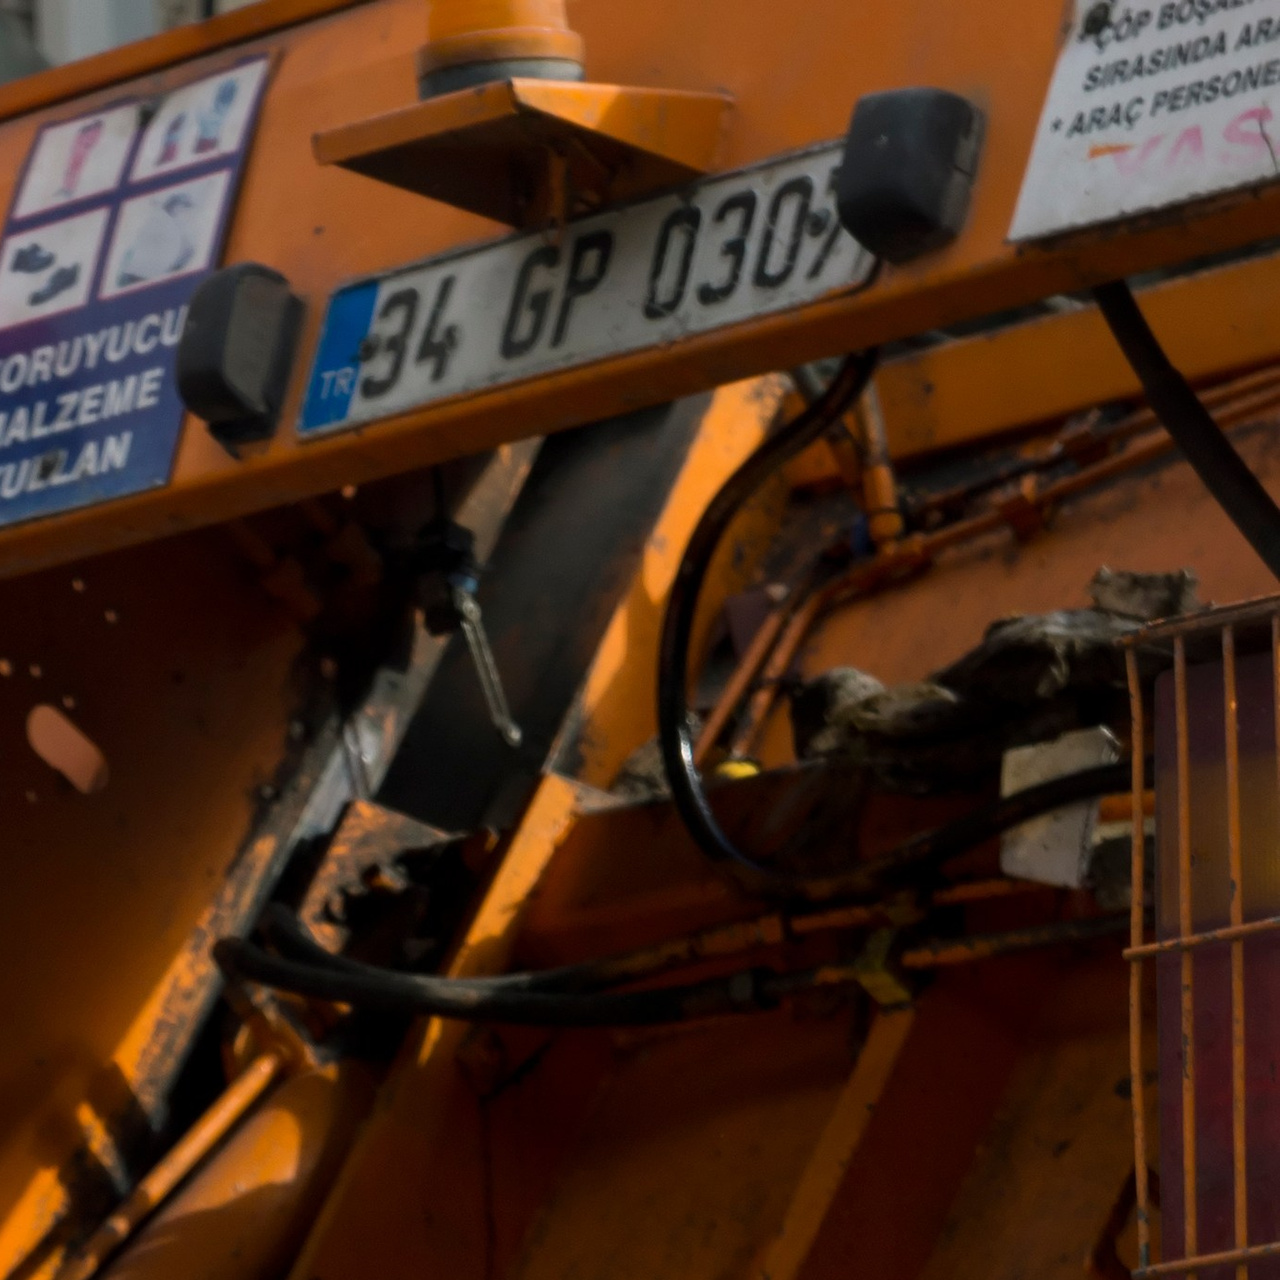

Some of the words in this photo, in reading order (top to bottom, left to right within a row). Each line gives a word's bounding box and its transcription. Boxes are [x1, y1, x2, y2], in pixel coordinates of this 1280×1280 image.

[1083, 30, 1227, 92] SIRASINDA
[1066, 97, 1144, 138] ARAÇ
[361, 275, 459, 399] 34
[499, 229, 614, 360] GP
[321, 365, 354, 400] TR
